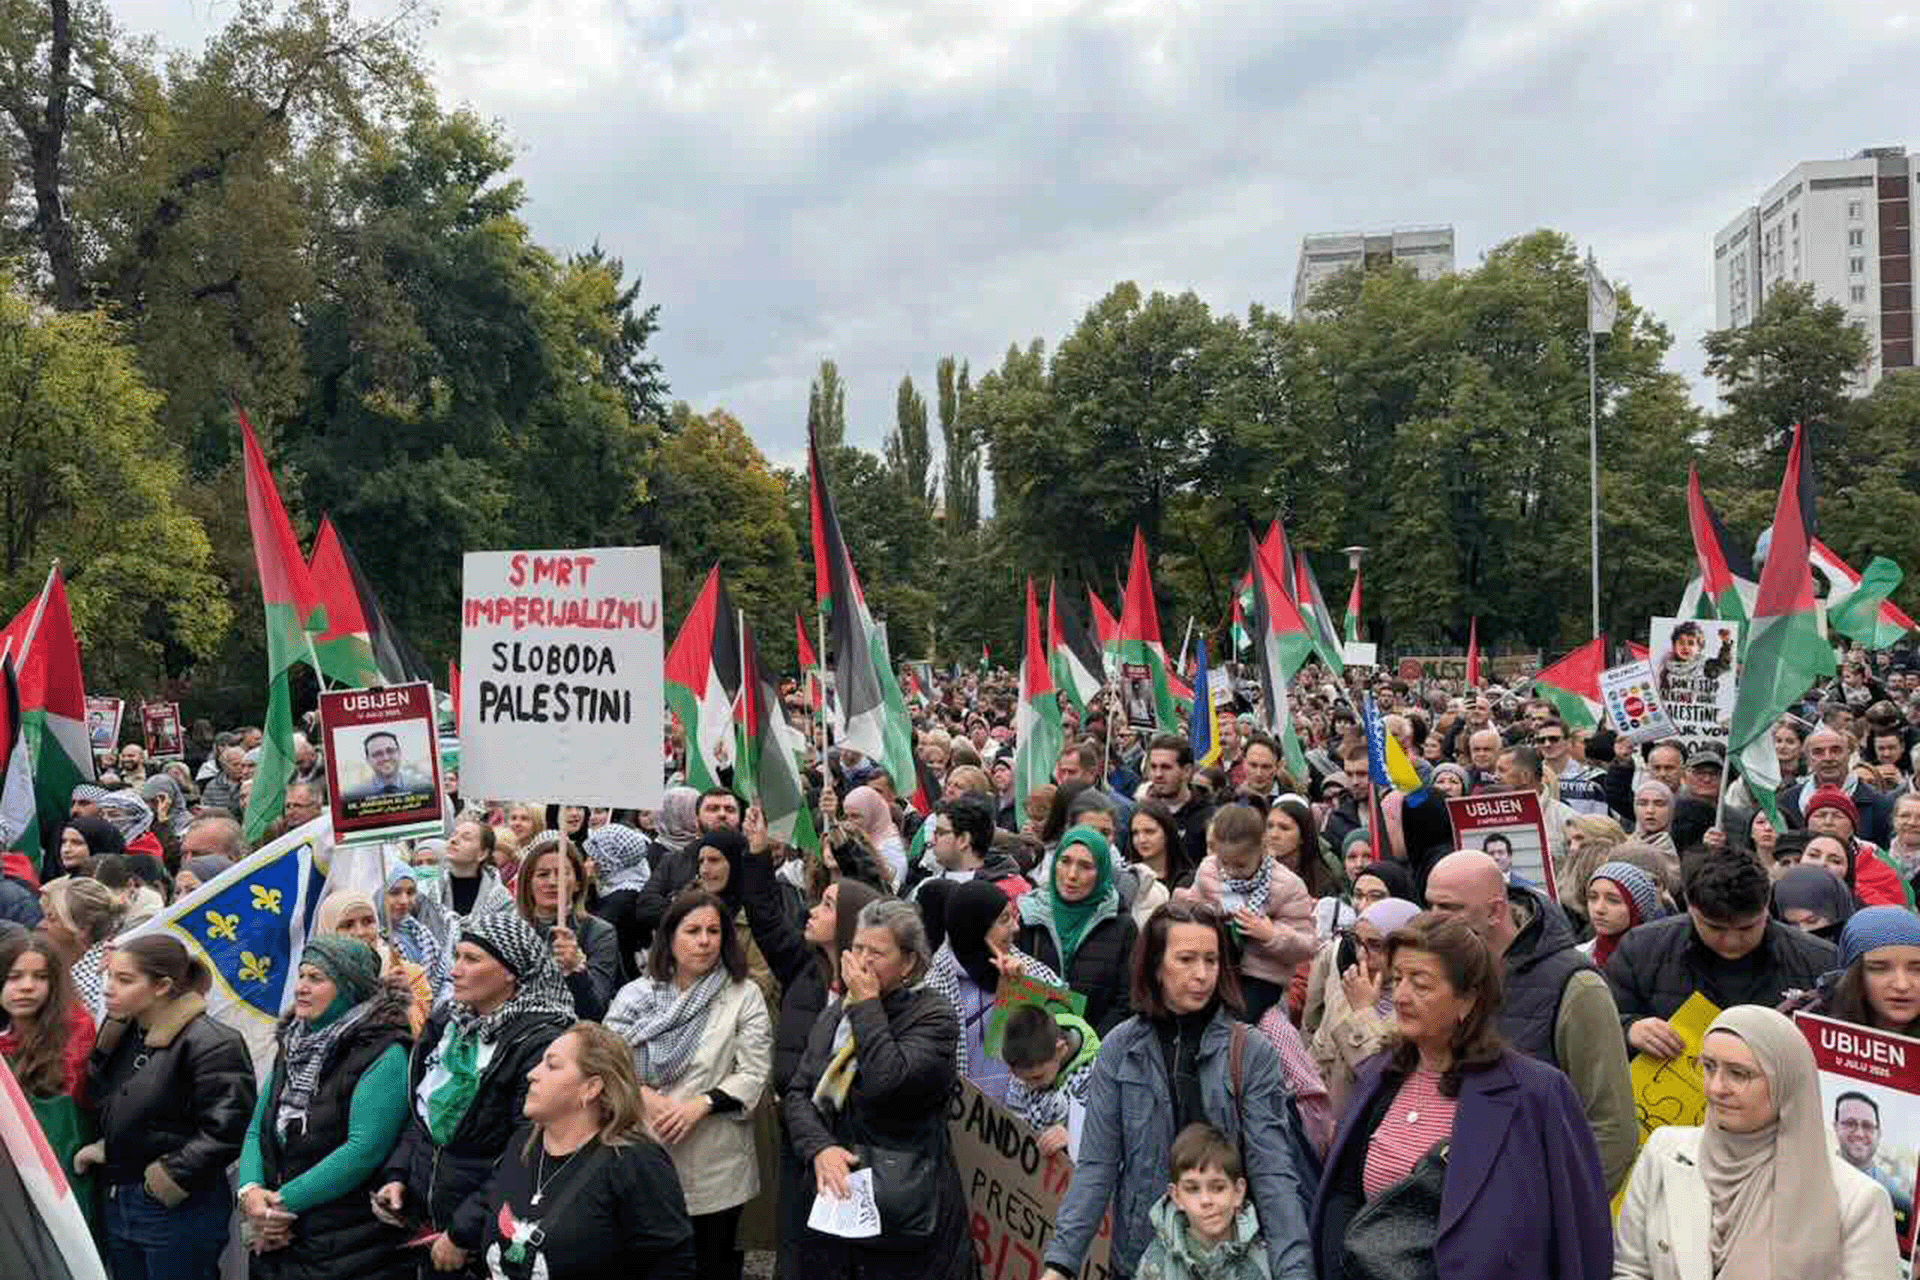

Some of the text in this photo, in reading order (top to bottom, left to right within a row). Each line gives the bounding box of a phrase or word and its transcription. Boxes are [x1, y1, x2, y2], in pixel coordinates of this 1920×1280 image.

[509, 554, 596, 587] SMRT
[464, 597, 657, 631] IMPERIJALIZMU
[492, 642, 616, 676] SLOBODA
[342, 690, 410, 711] UBIJEN
[479, 680, 631, 724] PALESTINI
[1665, 703, 1721, 722] ALESTINE
[1464, 798, 1523, 817] UBIJEN
[1820, 1027, 1905, 1068] UBIJEN
